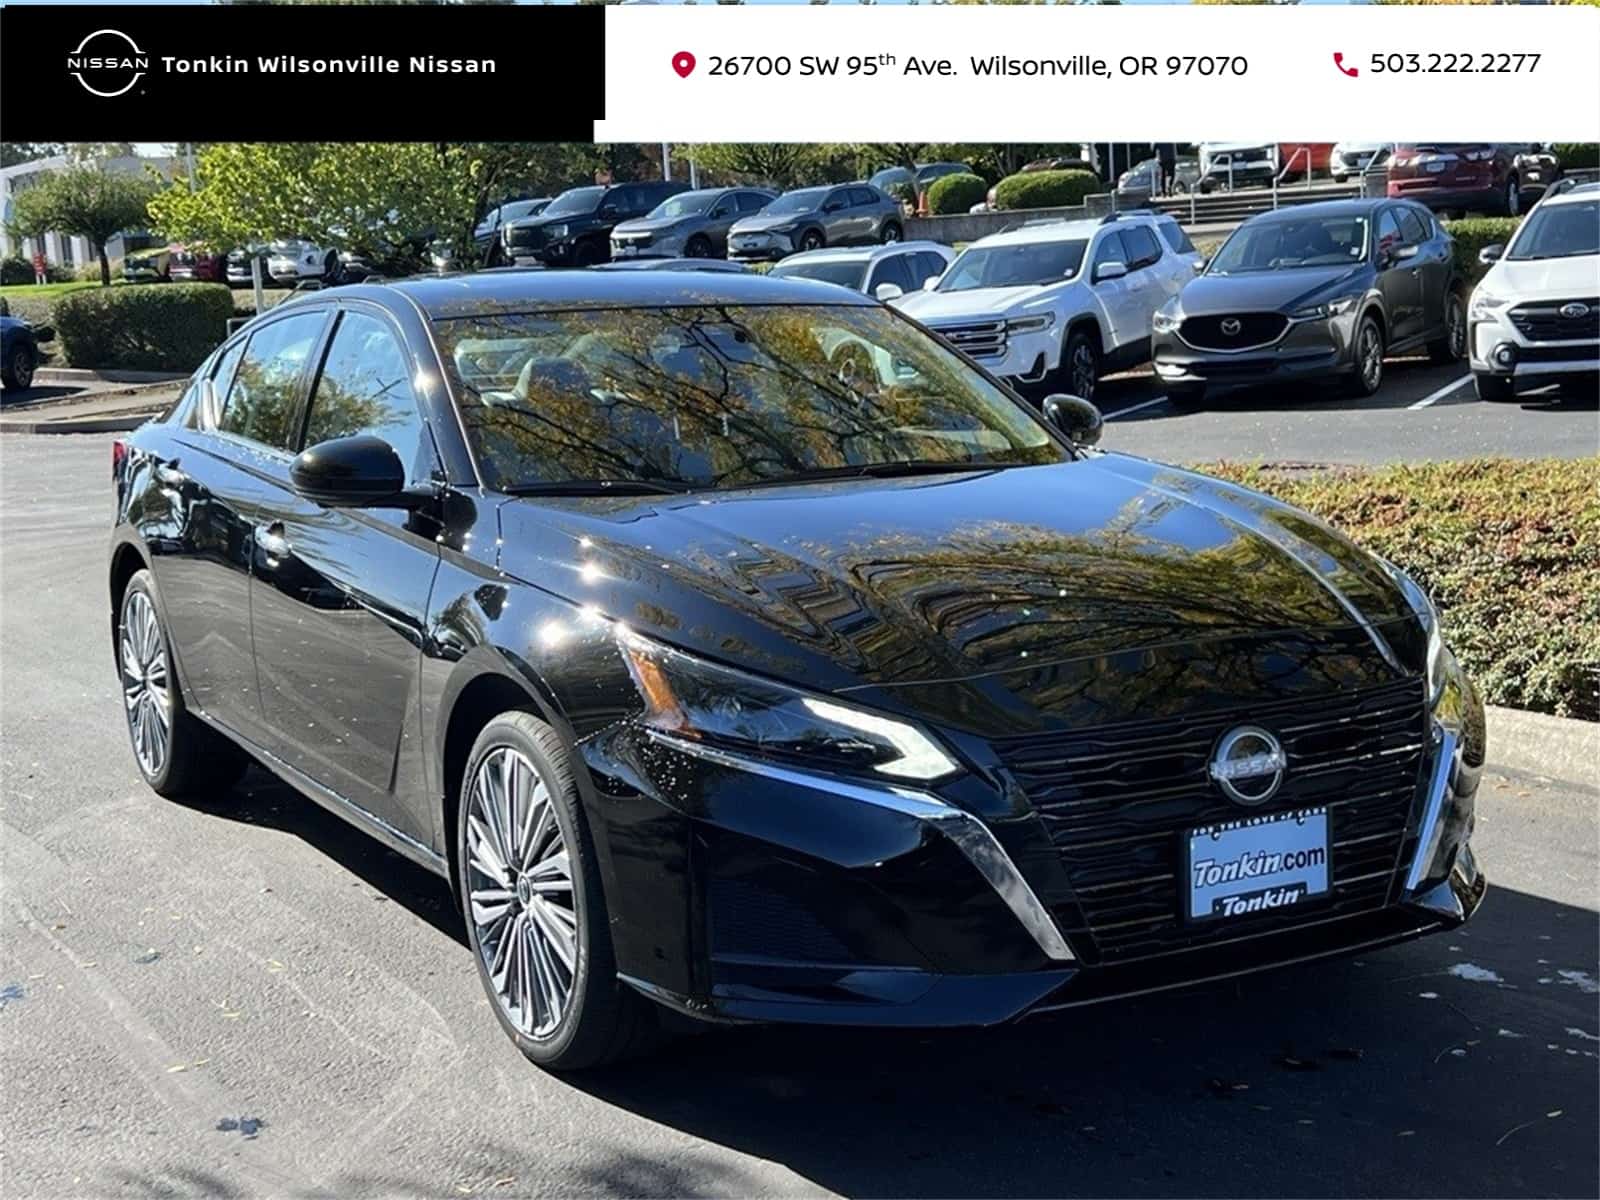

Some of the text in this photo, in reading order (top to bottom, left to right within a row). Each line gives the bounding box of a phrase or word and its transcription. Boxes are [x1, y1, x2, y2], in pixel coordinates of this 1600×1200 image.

[1209, 750, 1287, 779] NISSAN
[1194, 847, 1325, 888] Tonkin.com
[1221, 888, 1299, 917] Tonkin
